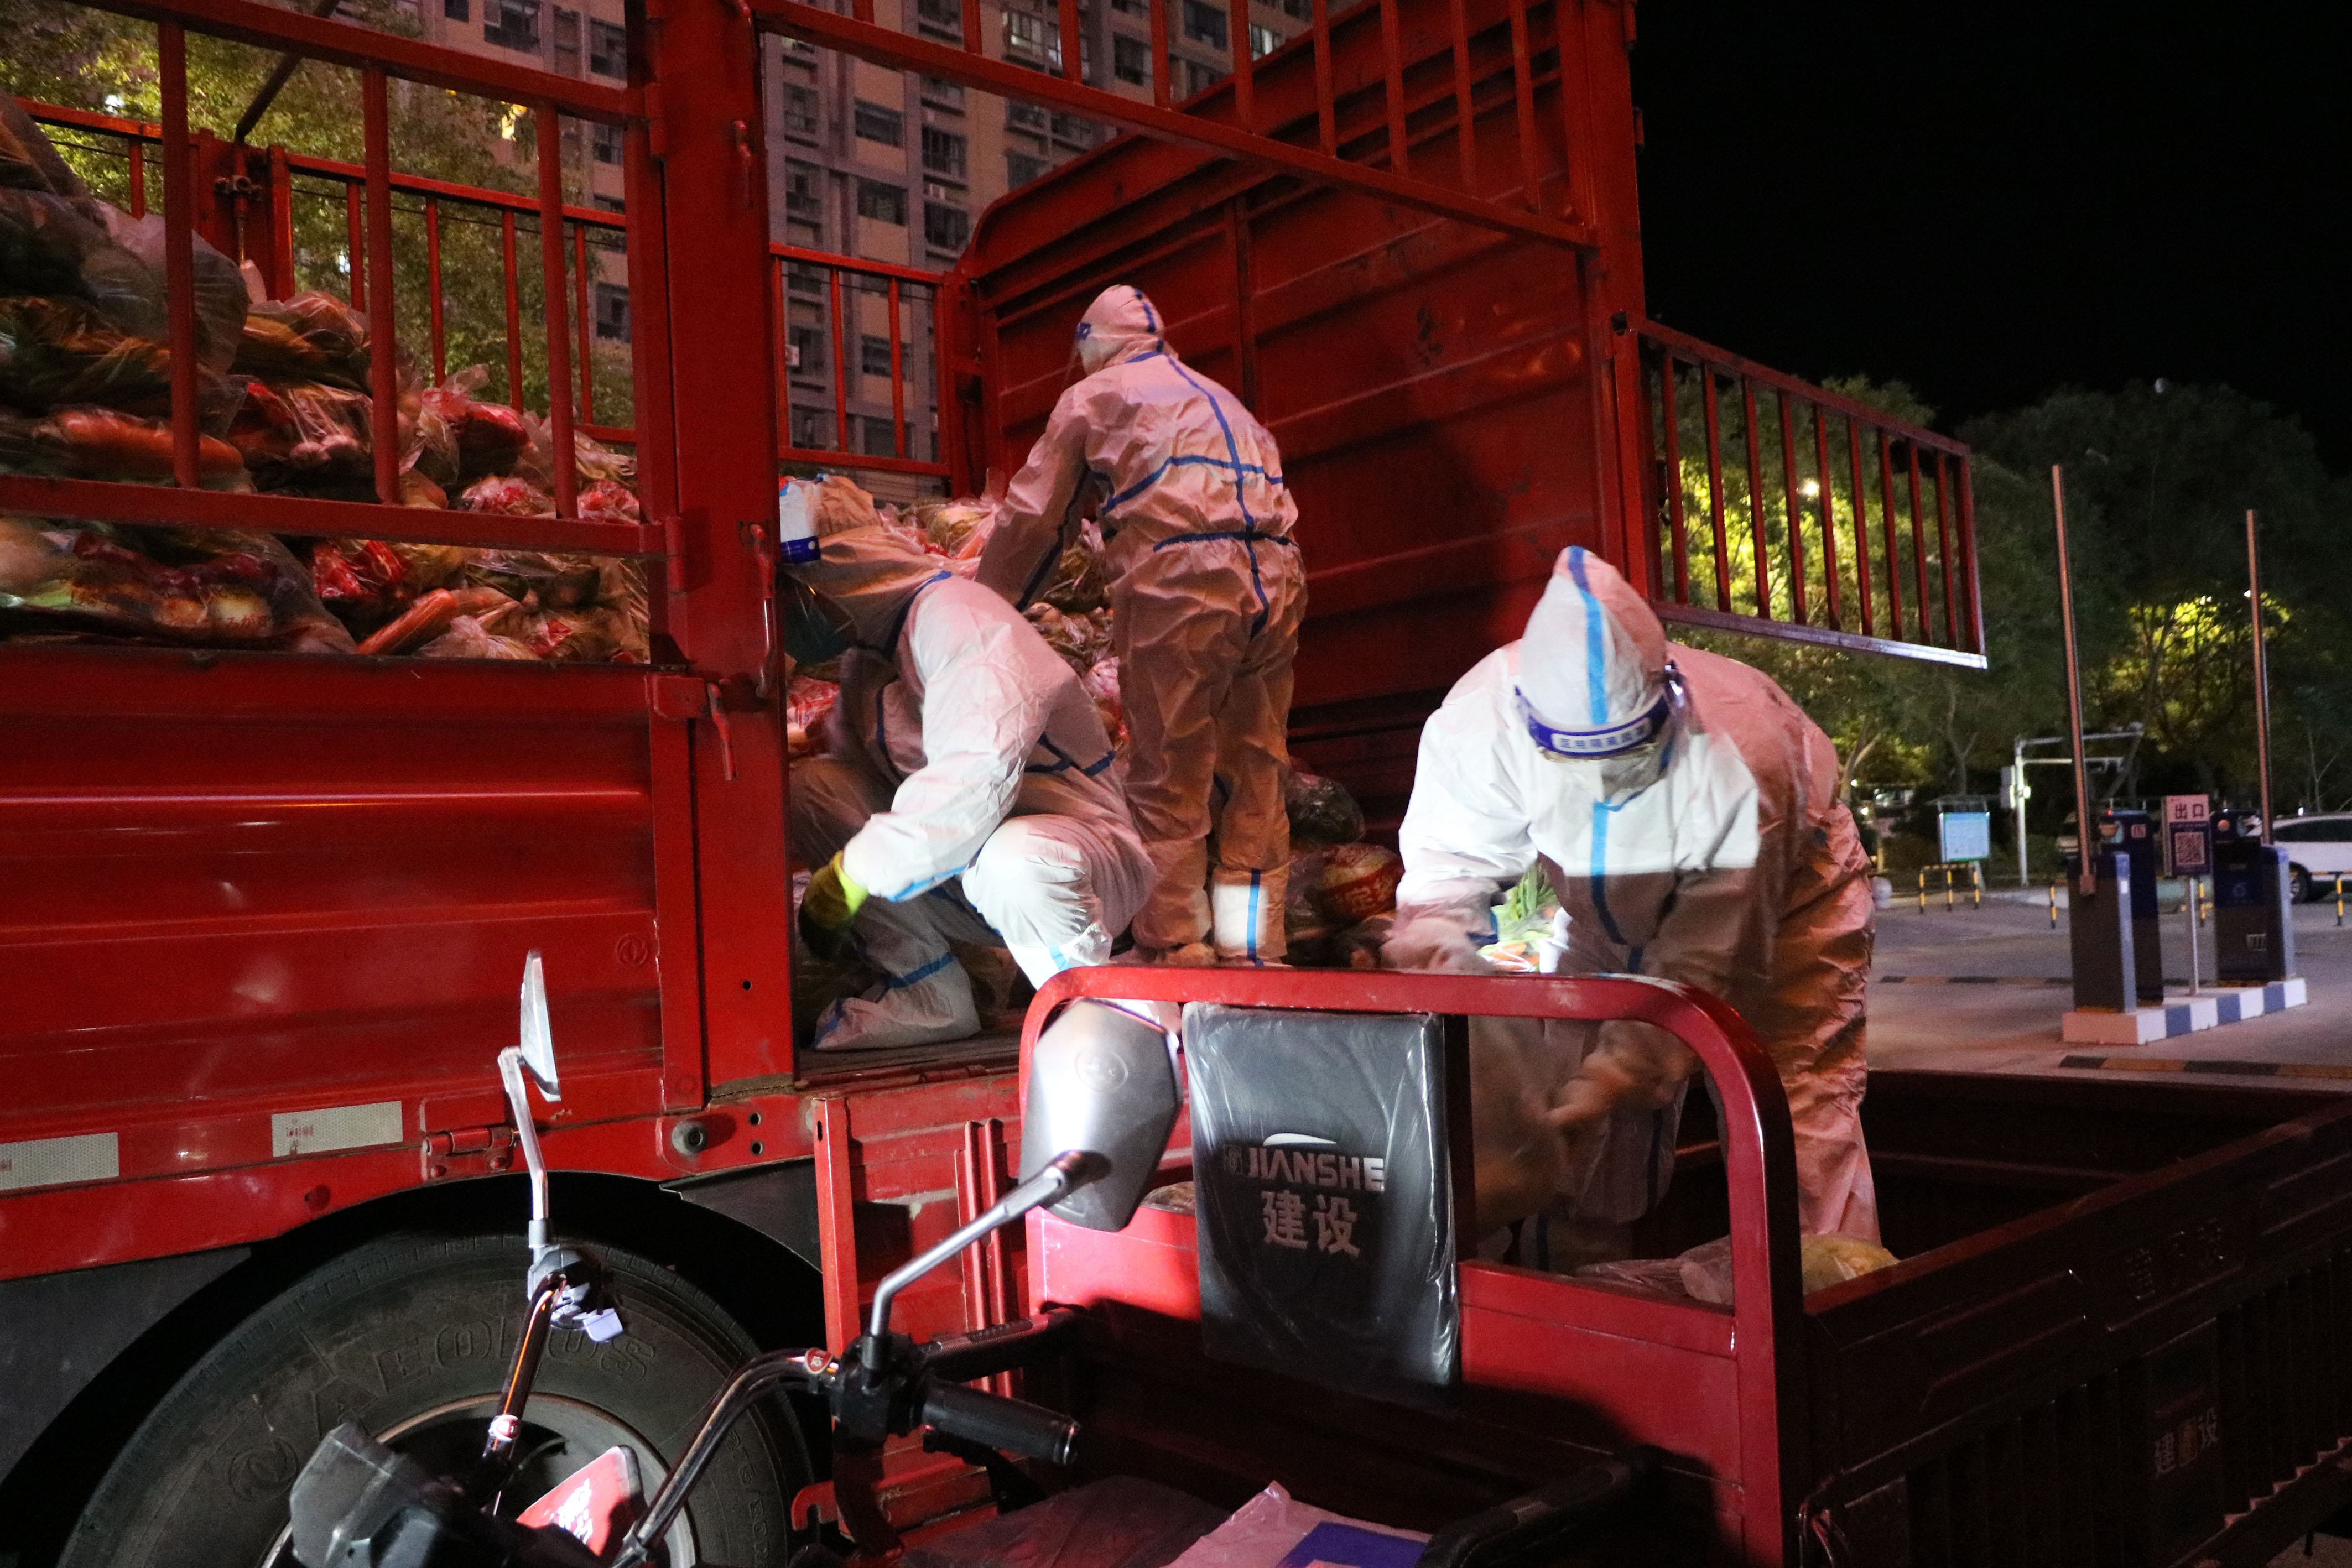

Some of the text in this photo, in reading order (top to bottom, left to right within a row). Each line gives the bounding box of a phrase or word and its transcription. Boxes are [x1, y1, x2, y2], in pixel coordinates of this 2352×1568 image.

[2174, 803, 2204, 819] 出口
[1247, 1147, 1386, 1192] JIANSHE
[1261, 1189, 1360, 1258] 建设
